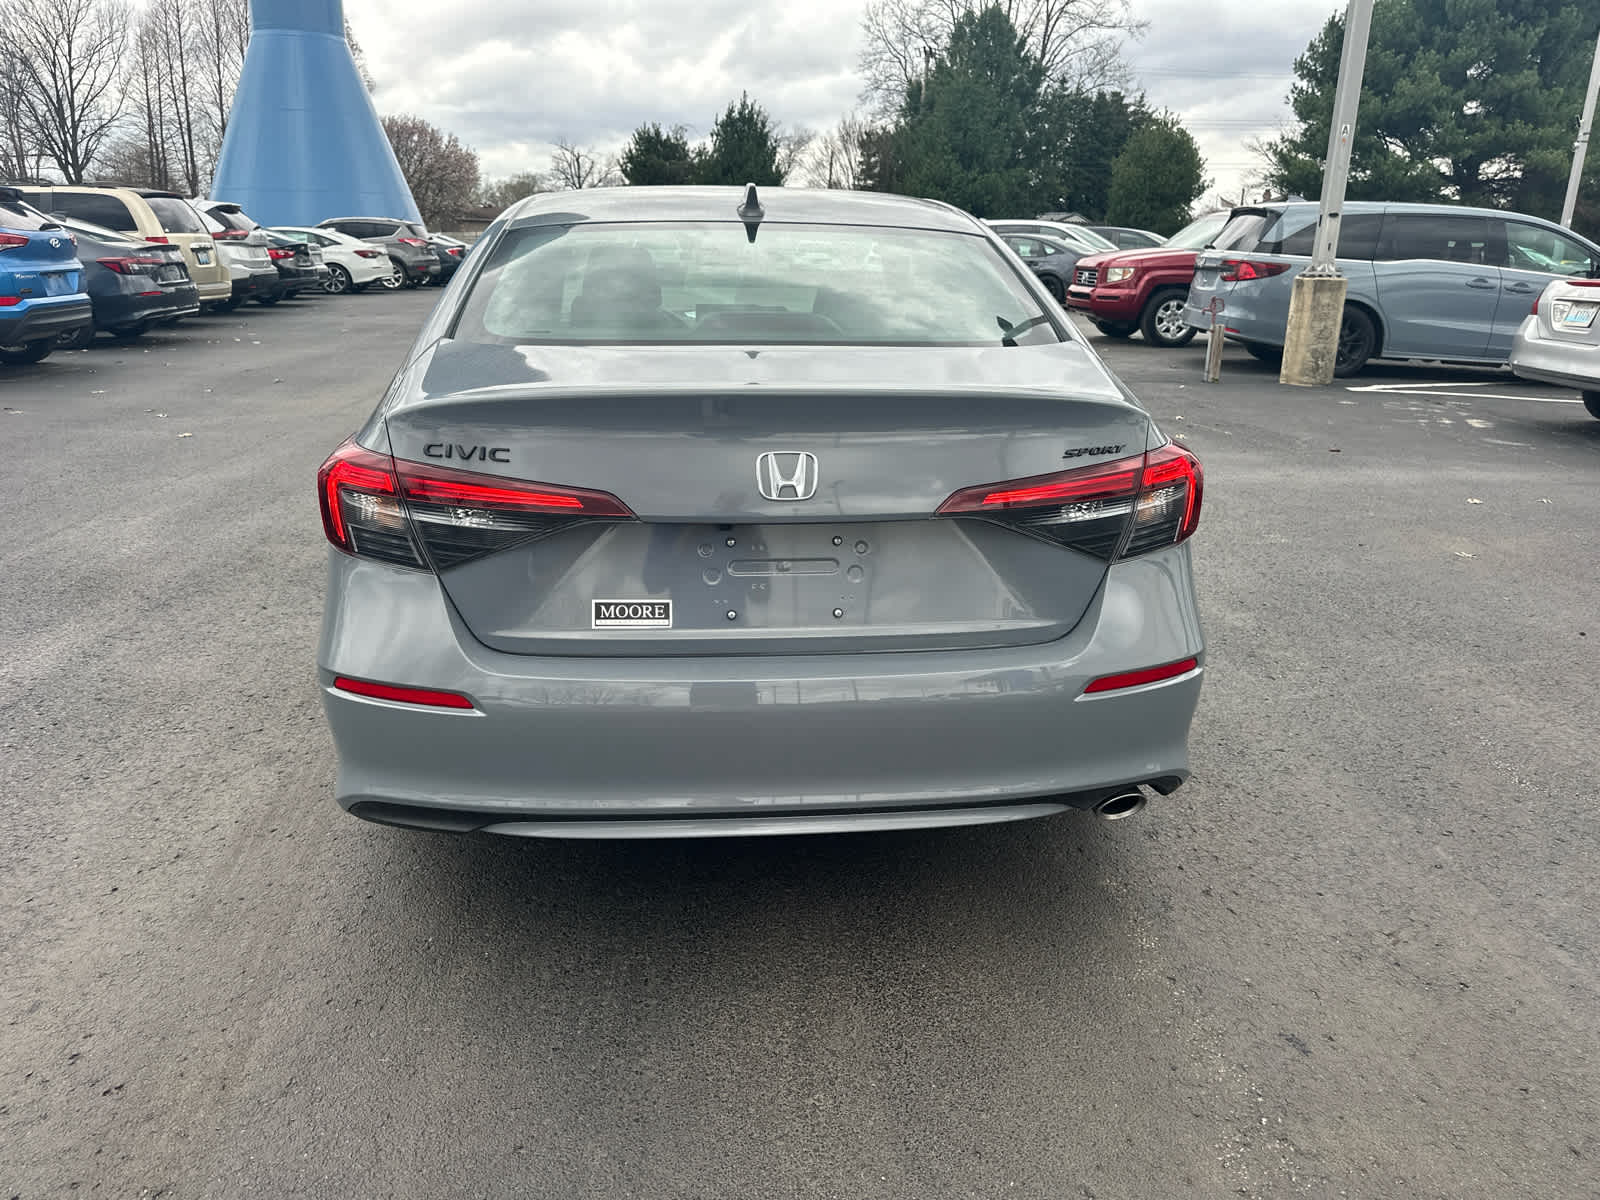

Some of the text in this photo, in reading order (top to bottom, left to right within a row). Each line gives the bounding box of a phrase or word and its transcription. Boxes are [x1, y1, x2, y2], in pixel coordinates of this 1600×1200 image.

[423, 443, 511, 463] CIVIC
[1062, 444, 1127, 459] SPORT
[600, 604, 665, 619] MOORE
